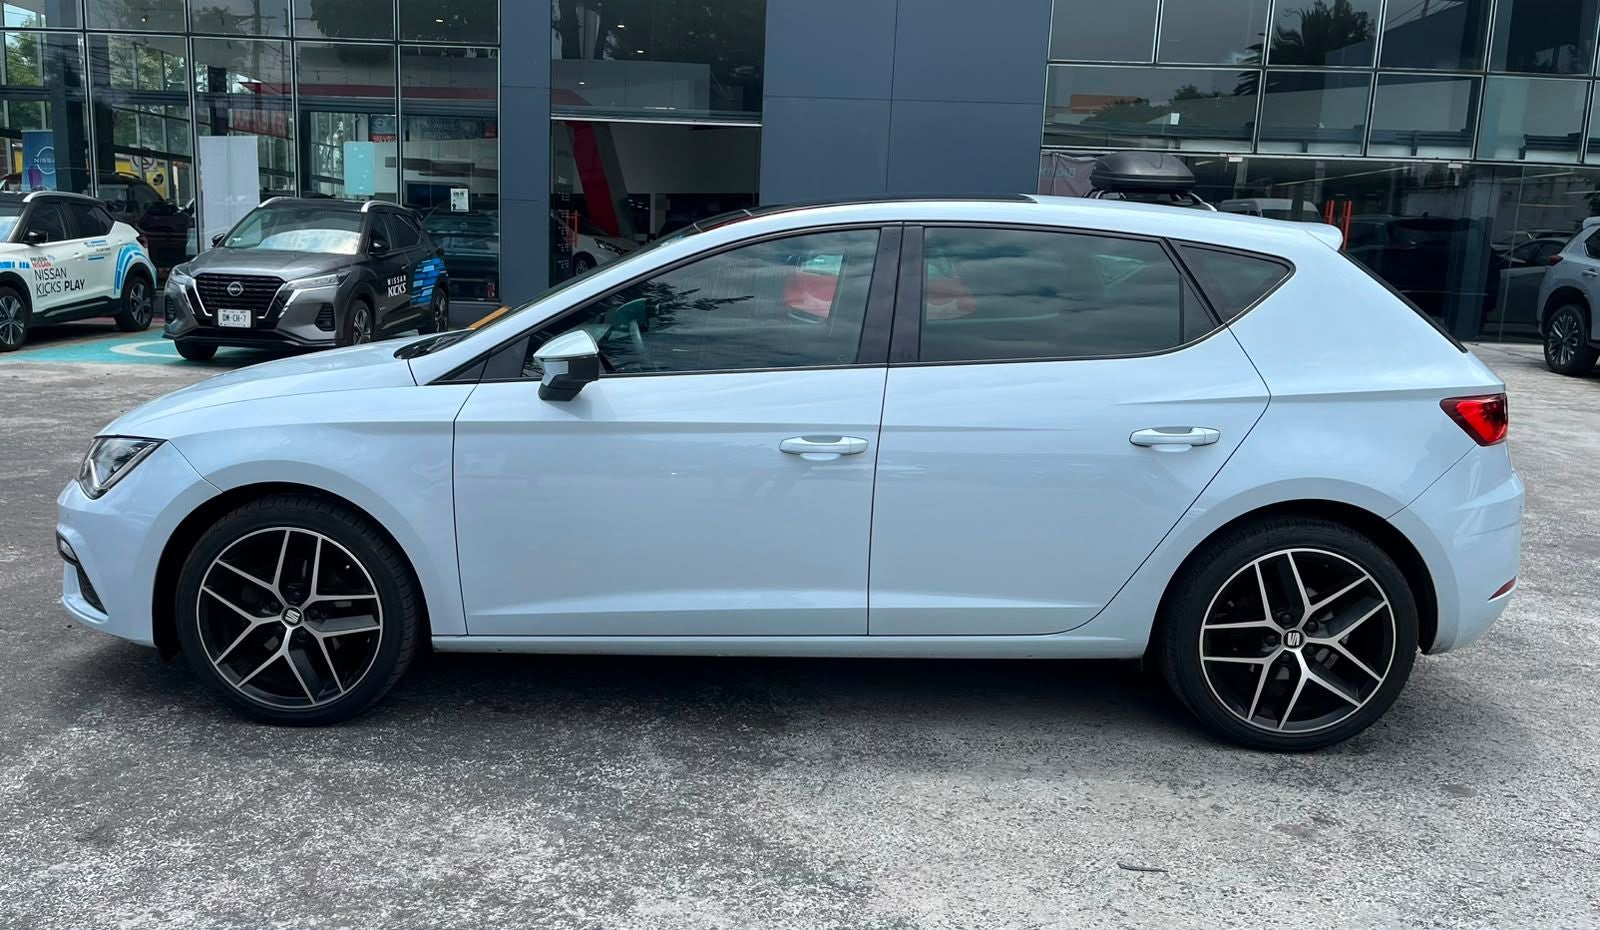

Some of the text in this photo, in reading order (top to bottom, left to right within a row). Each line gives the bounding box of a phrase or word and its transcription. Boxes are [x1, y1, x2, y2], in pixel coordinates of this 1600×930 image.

[34, 268, 67, 280] NISSAN
[387, 275, 407, 286] NISSAN
[36, 279, 85, 295] KICKS PLAY
[388, 283, 407, 298] KICKS
